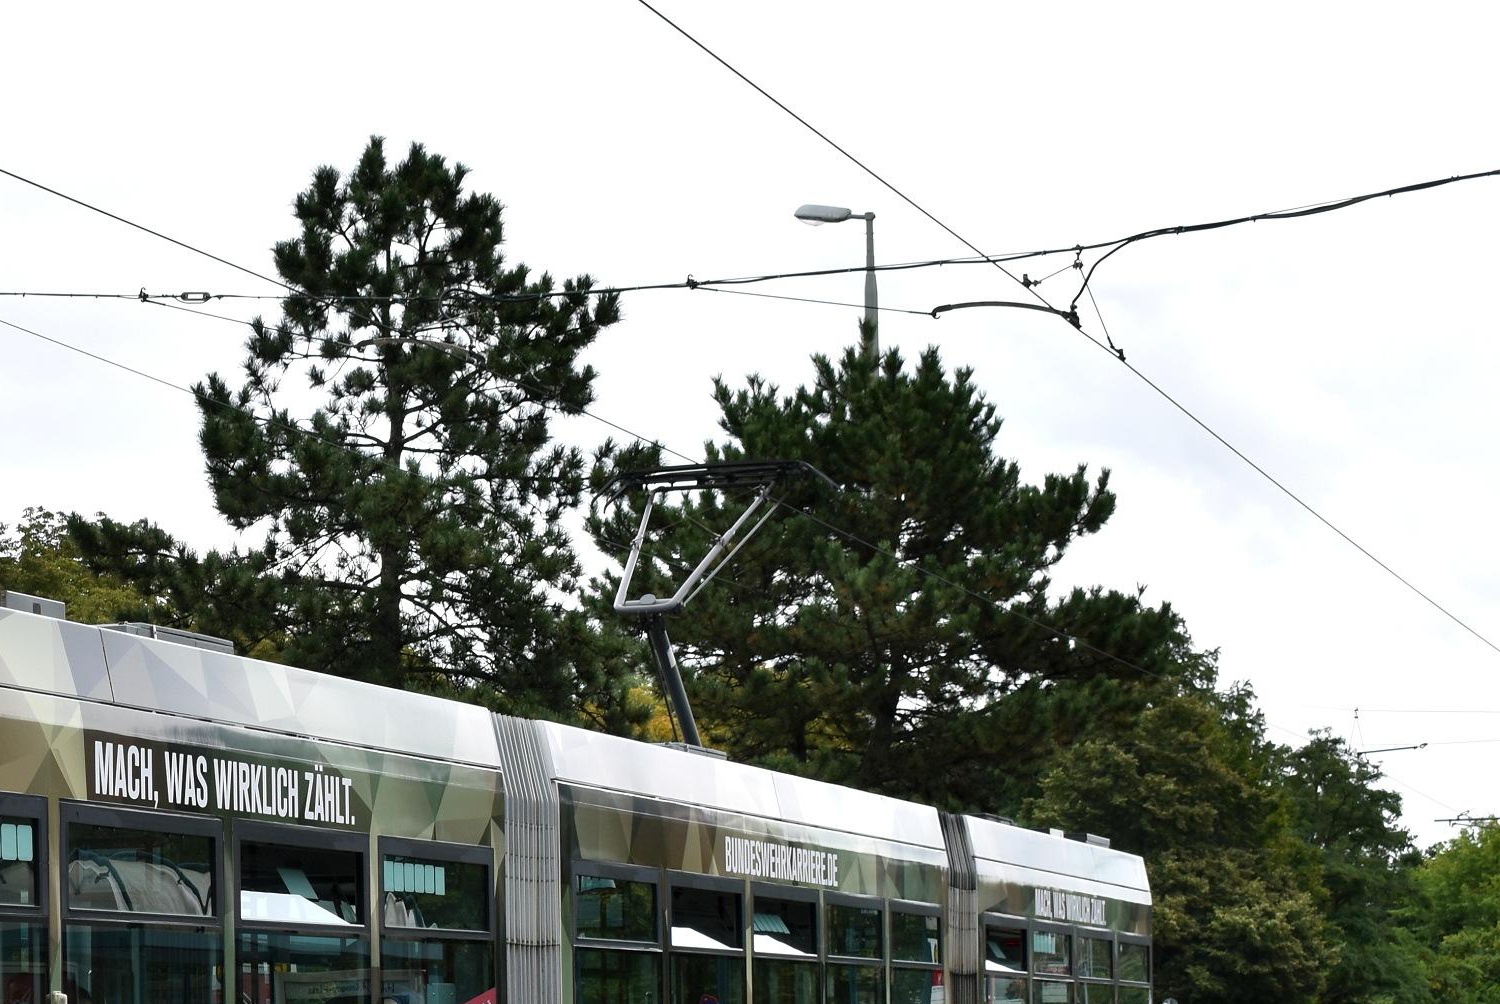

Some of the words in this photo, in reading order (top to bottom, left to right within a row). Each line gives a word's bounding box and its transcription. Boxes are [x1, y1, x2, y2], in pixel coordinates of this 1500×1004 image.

[94, 740, 159, 809] MACH,
[164, 751, 208, 808] WAS
[213, 758, 299, 818] WIRKLICH
[304, 764, 356, 825] ZÄHLT.
[725, 836, 838, 887] BUNDESWEHRKARRIERE.DE
